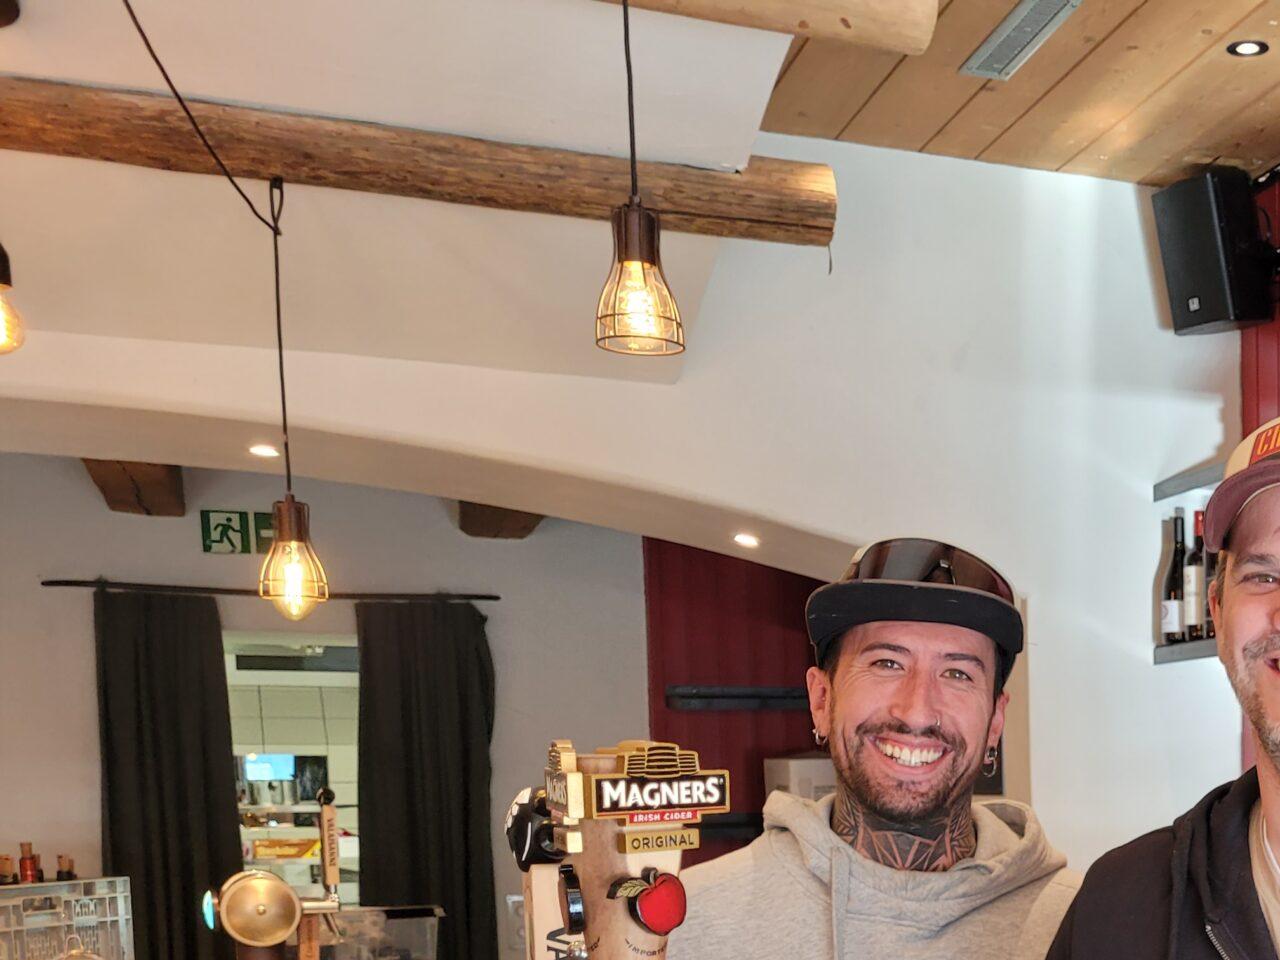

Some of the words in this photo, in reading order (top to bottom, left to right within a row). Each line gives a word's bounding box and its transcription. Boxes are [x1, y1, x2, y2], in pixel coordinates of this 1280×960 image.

[602, 778, 721, 809] MAGNERS
[633, 813, 661, 823] IRISH
[664, 811, 693, 822] CIDER
[631, 835, 695, 850] ORIGINAL
